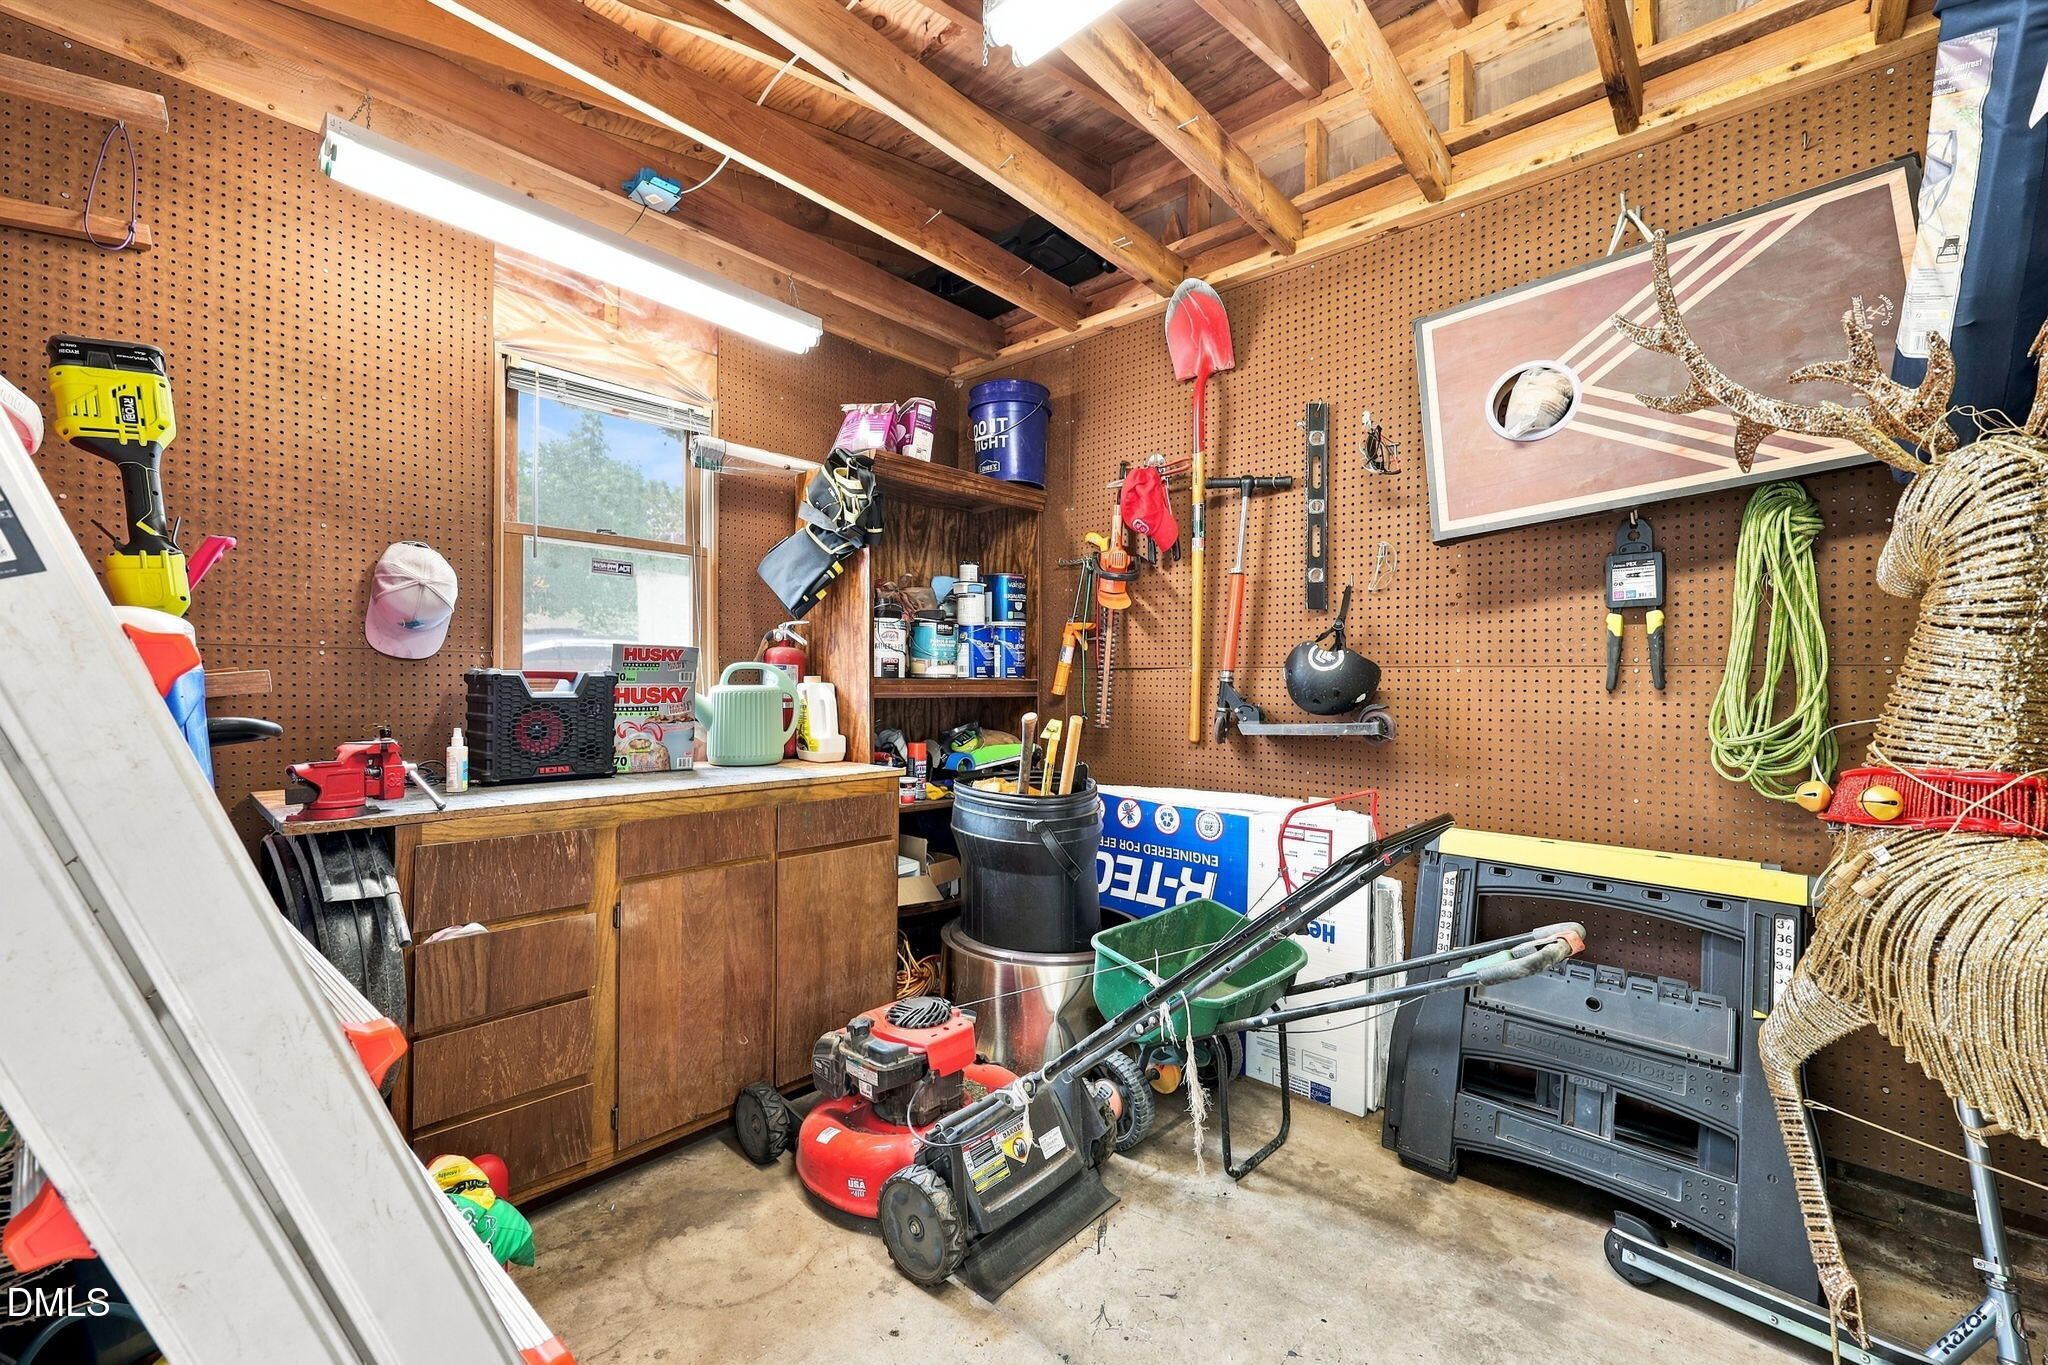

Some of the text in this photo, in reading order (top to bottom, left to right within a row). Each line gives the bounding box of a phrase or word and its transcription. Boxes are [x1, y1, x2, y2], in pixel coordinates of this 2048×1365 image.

[123, 397, 138, 424] RYOBI
[990, 417, 1009, 435] IT
[624, 646, 685, 662] HUSKY
[614, 686, 689, 704] HUSKY
[614, 756, 627, 766] 70
[1119, 840, 1141, 853] FOR
[1143, 843, 1219, 868] ENGINEERED
[1444, 877, 1455, 886] 36
[1443, 888, 1454, 896] 35
[1442, 899, 1453, 907] 34
[1441, 909, 1452, 919] 33
[1440, 921, 1451, 930] 32
[1438, 932, 1450, 941] 31
[1776, 933, 1793, 944] 36
[1437, 943, 1449, 952] 30
[1776, 947, 1793, 958] 35
[1775, 961, 1792, 971] 34
[1507, 1029, 1685, 1084] ADJUSTABLE SAWHORSE
[1003, 1122, 1024, 1139] DANGER
[848, 1179, 866, 1189] USA
[1936, 1305, 1988, 1355] Razor
